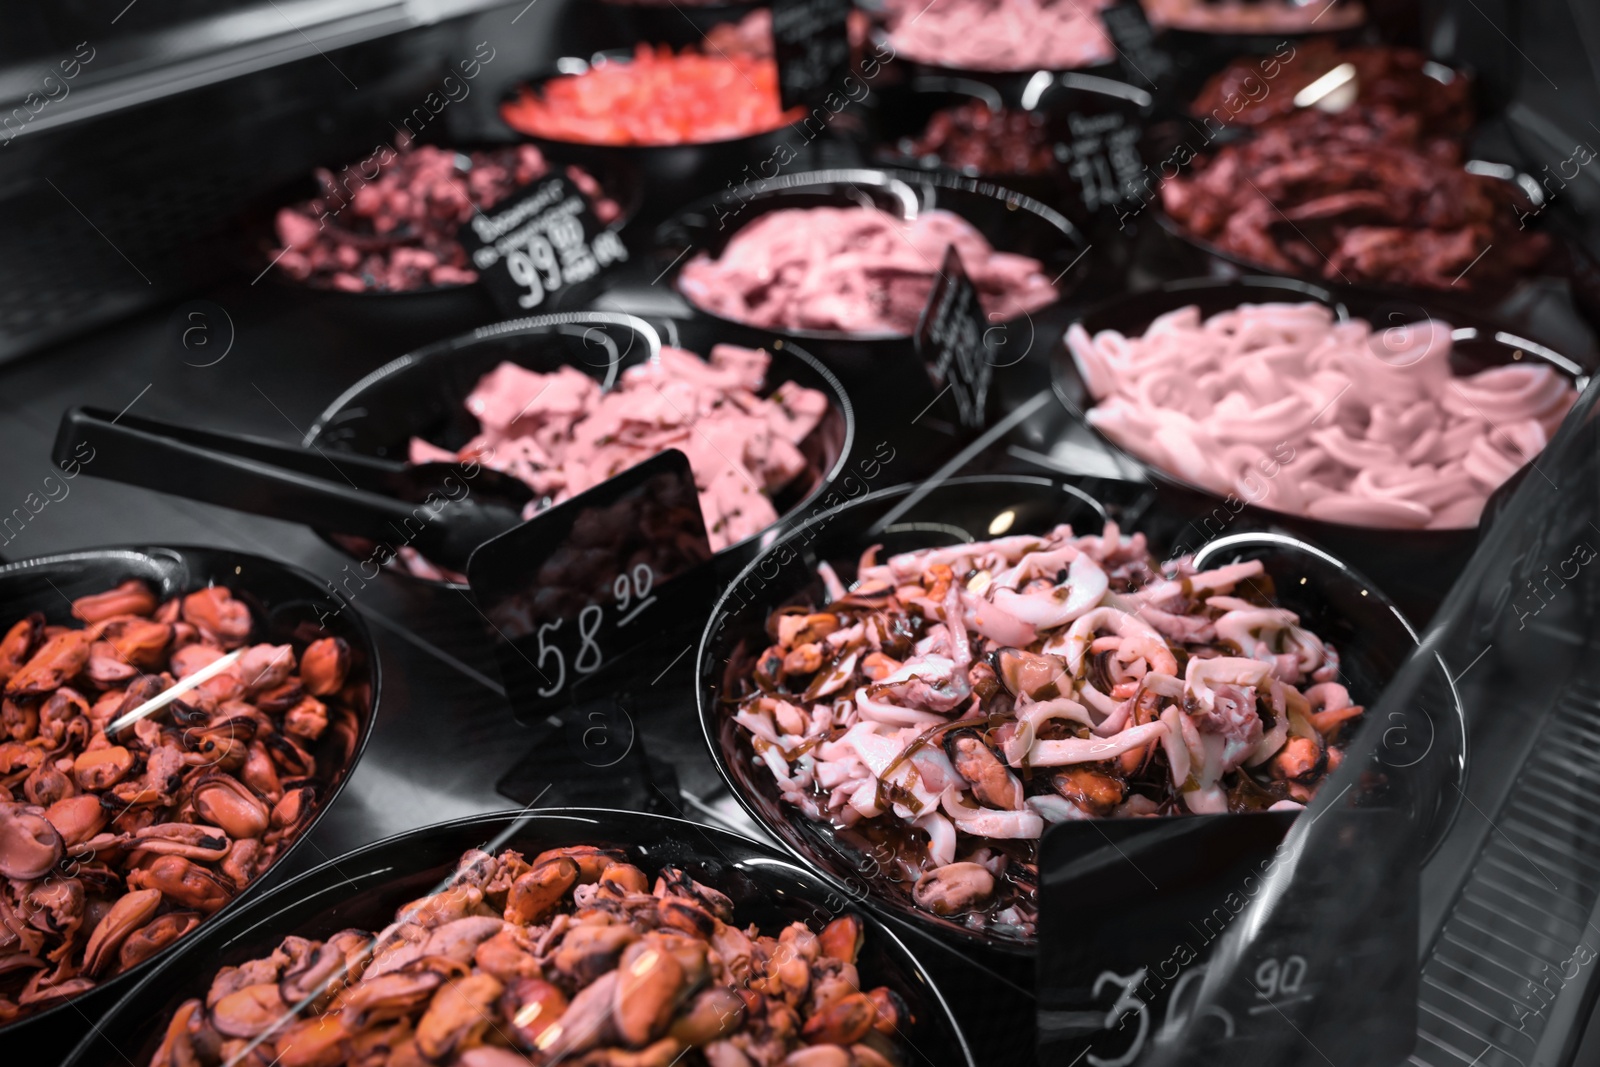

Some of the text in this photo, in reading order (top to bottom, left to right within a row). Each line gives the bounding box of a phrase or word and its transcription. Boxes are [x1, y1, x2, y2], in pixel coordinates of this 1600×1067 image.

[536, 562, 653, 698] 58 90
[1255, 955, 1308, 999] 90
